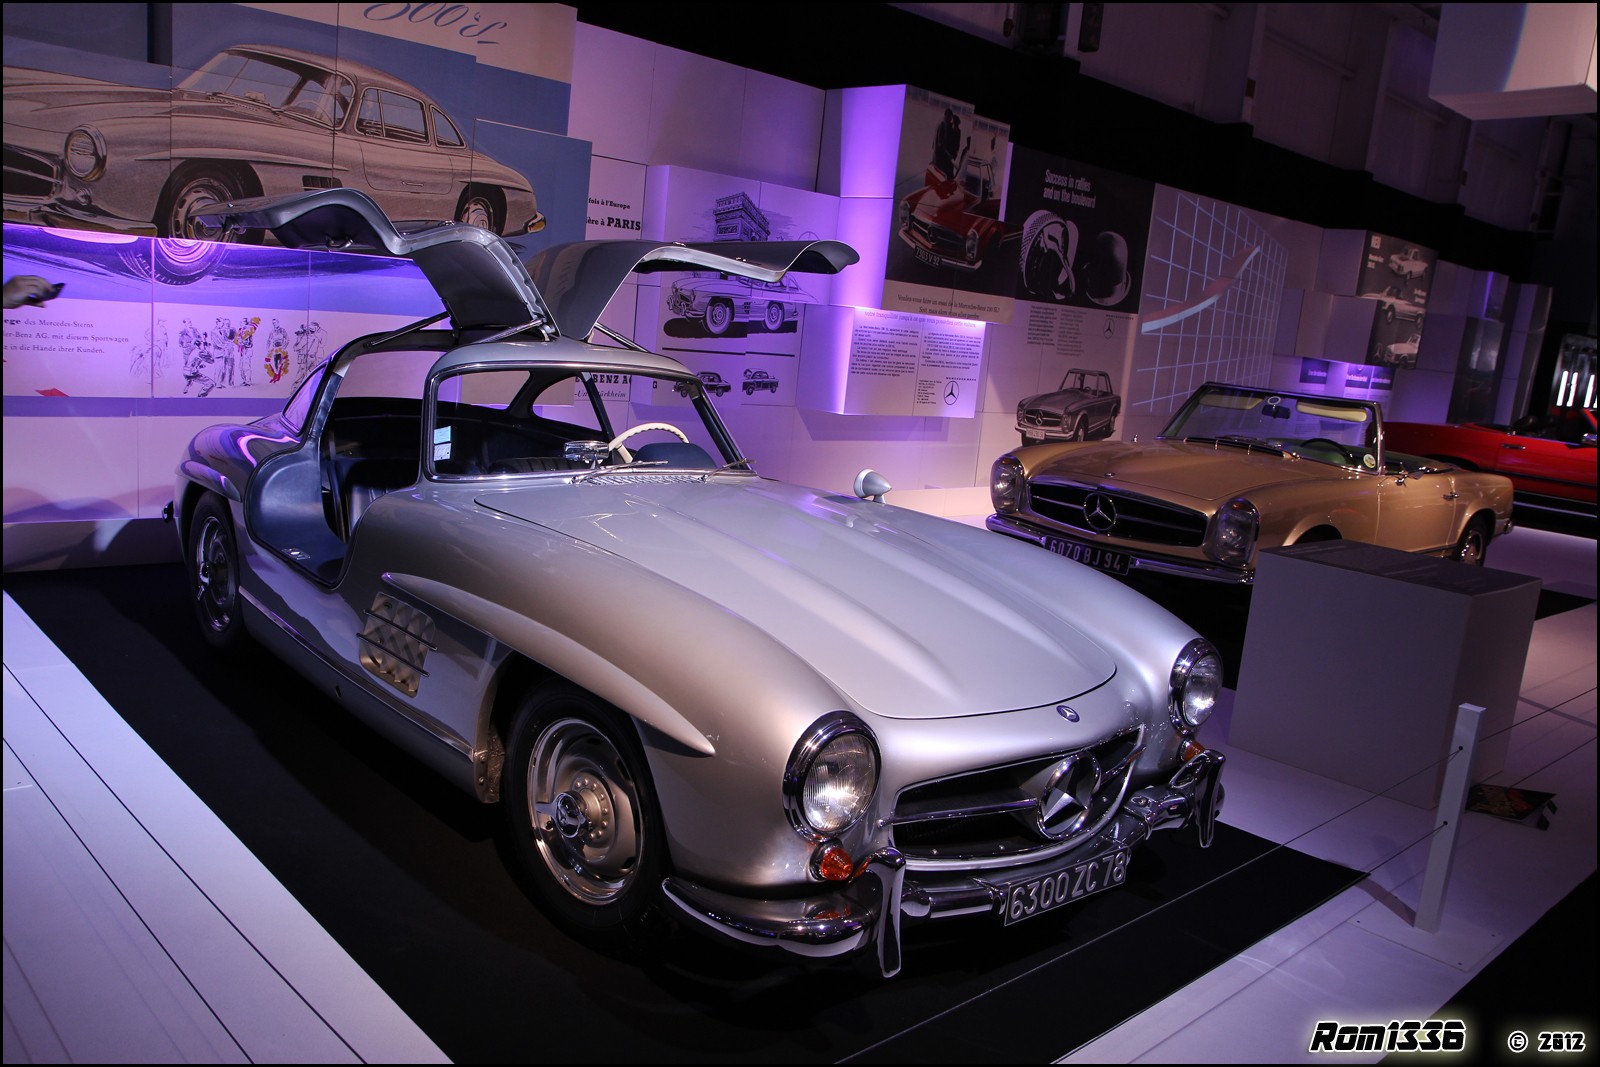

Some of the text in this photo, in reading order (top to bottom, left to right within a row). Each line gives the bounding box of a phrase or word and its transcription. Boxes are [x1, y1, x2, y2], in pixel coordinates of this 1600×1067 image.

[1045, 169, 1091, 192] Success in rallies
[605, 200, 631, 210] l'Europe
[1043, 187, 1097, 209] and on the boulevard
[600, 218, 605, 227] à
[607, 216, 641, 231] PARIS
[39, 319, 94, 329] Mercedes-Sterns
[66, 333, 89, 341] diesem
[91, 334, 129, 344] Sportwagen
[33, 344, 56, 353] Hände
[76, 346, 105, 354] Kunden.
[1049, 539, 1121, 571] 6070 BJ 94
[1010, 851, 1126, 920] 6300 ZC 78
